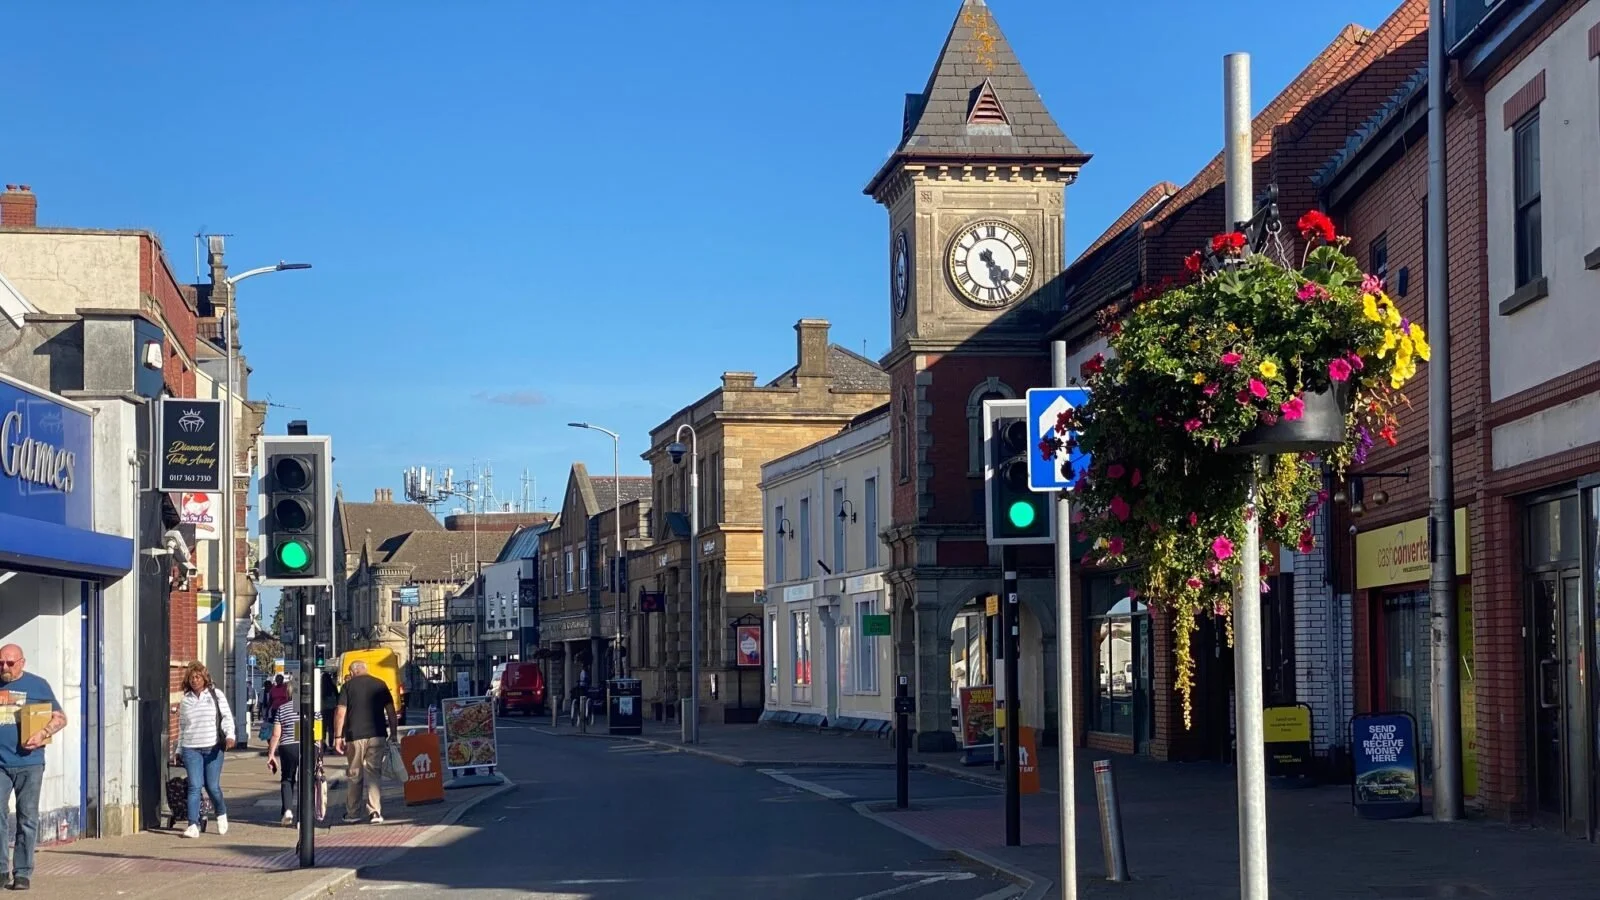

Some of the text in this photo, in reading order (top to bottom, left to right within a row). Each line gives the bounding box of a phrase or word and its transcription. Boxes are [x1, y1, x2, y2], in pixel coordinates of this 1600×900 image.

[169, 440, 215, 453] Diamond
[1, 411, 76, 493] Games
[166, 452, 216, 469] Take Away
[1368, 725, 1397, 733] SEND
[1371, 732, 1395, 740] AND
[1362, 739, 1404, 748] RECEIVE
[1365, 746, 1402, 756] MONEY
[1371, 754, 1397, 763] HERE
[425, 771, 437, 779] EAT
